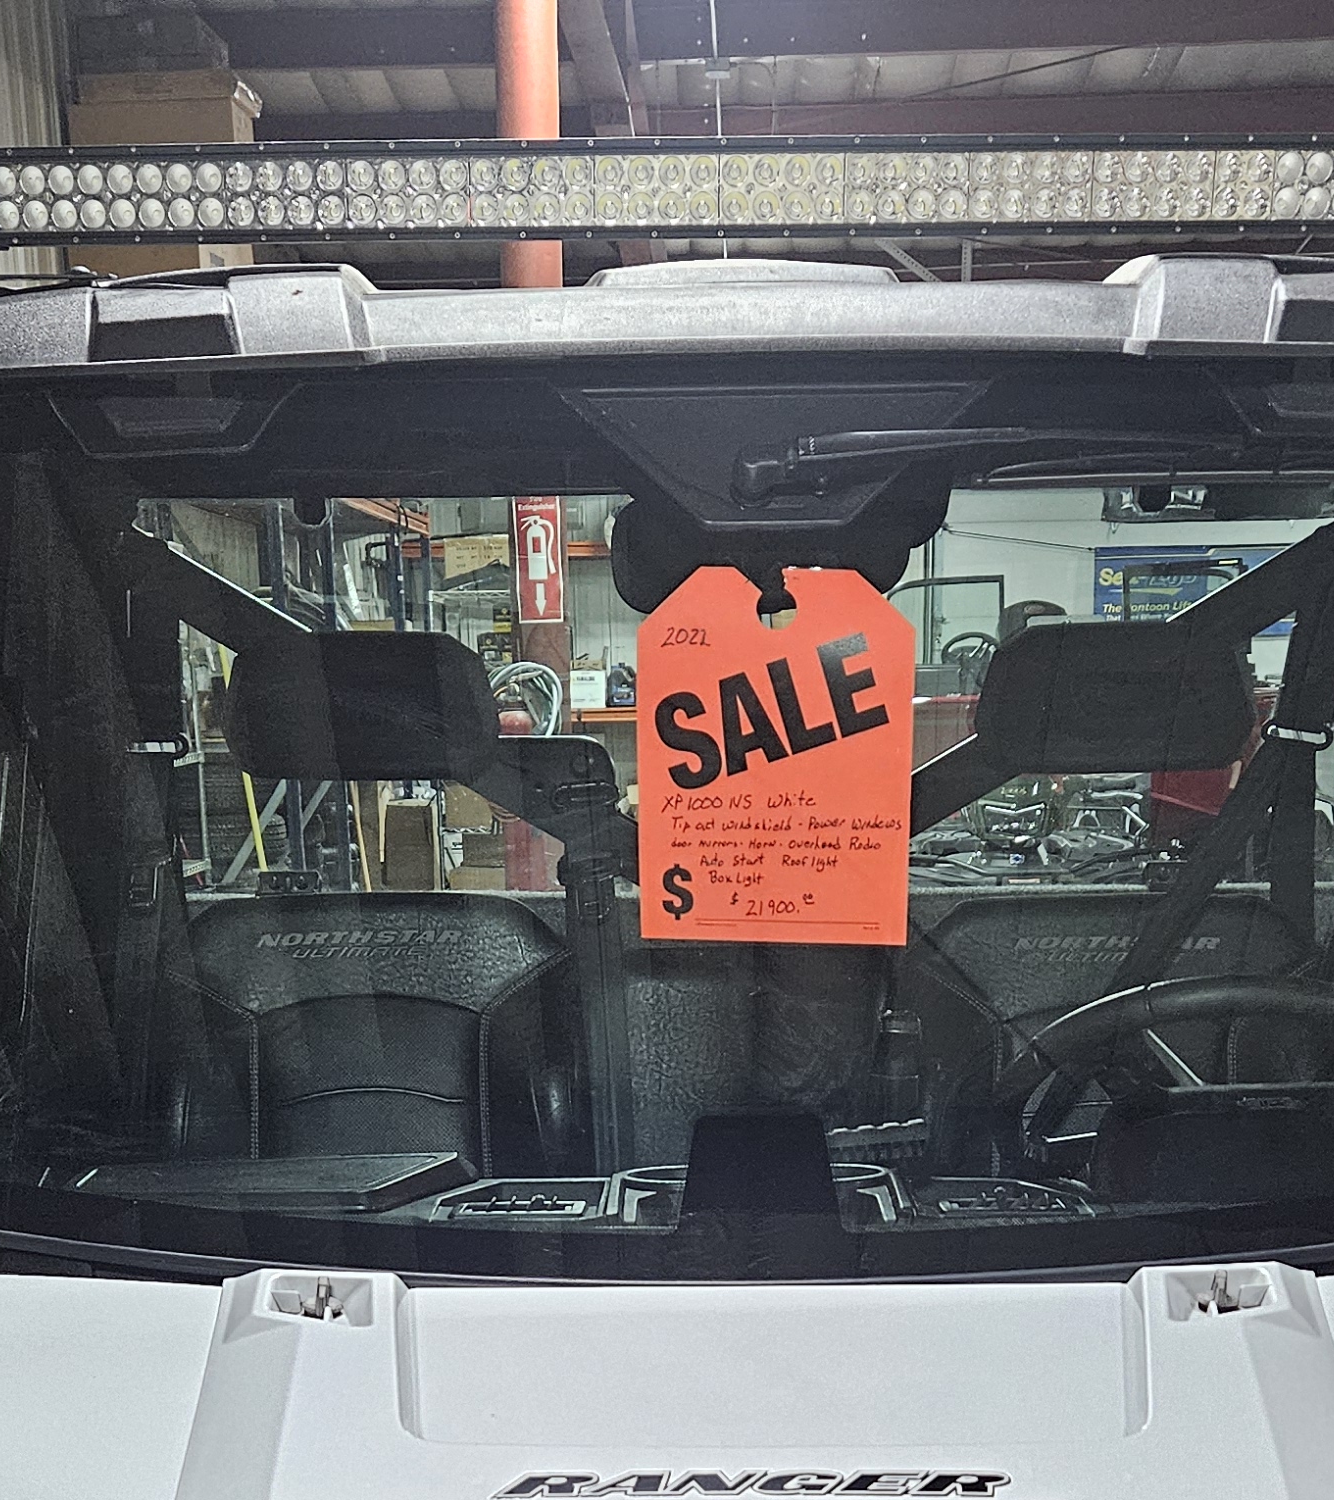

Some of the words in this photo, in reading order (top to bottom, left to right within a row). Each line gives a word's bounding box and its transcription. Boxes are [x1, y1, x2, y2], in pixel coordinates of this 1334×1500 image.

[517, 503, 557, 512] Extinguisher
[1130, 602, 1170, 612] ontoon
[660, 626, 711, 648] 2022
[655, 631, 890, 790] SALE
[660, 793, 684, 814] XP
[687, 796, 723, 811] 1000
[728, 793, 753, 810] NS
[766, 790, 816, 810] White
[671, 816, 691, 833] Tip
[807, 816, 845, 831] Power
[788, 836, 842, 851] Overhead
[848, 835, 882, 851] Radio
[733, 853, 765, 867] Start
[708, 869, 734, 885] Box
[662, 863, 694, 921] $
[256, 929, 464, 948] NORTHSTAR
[1013, 935, 1221, 950] NORTHAR
[291, 945, 427, 959] ULTIMATE
